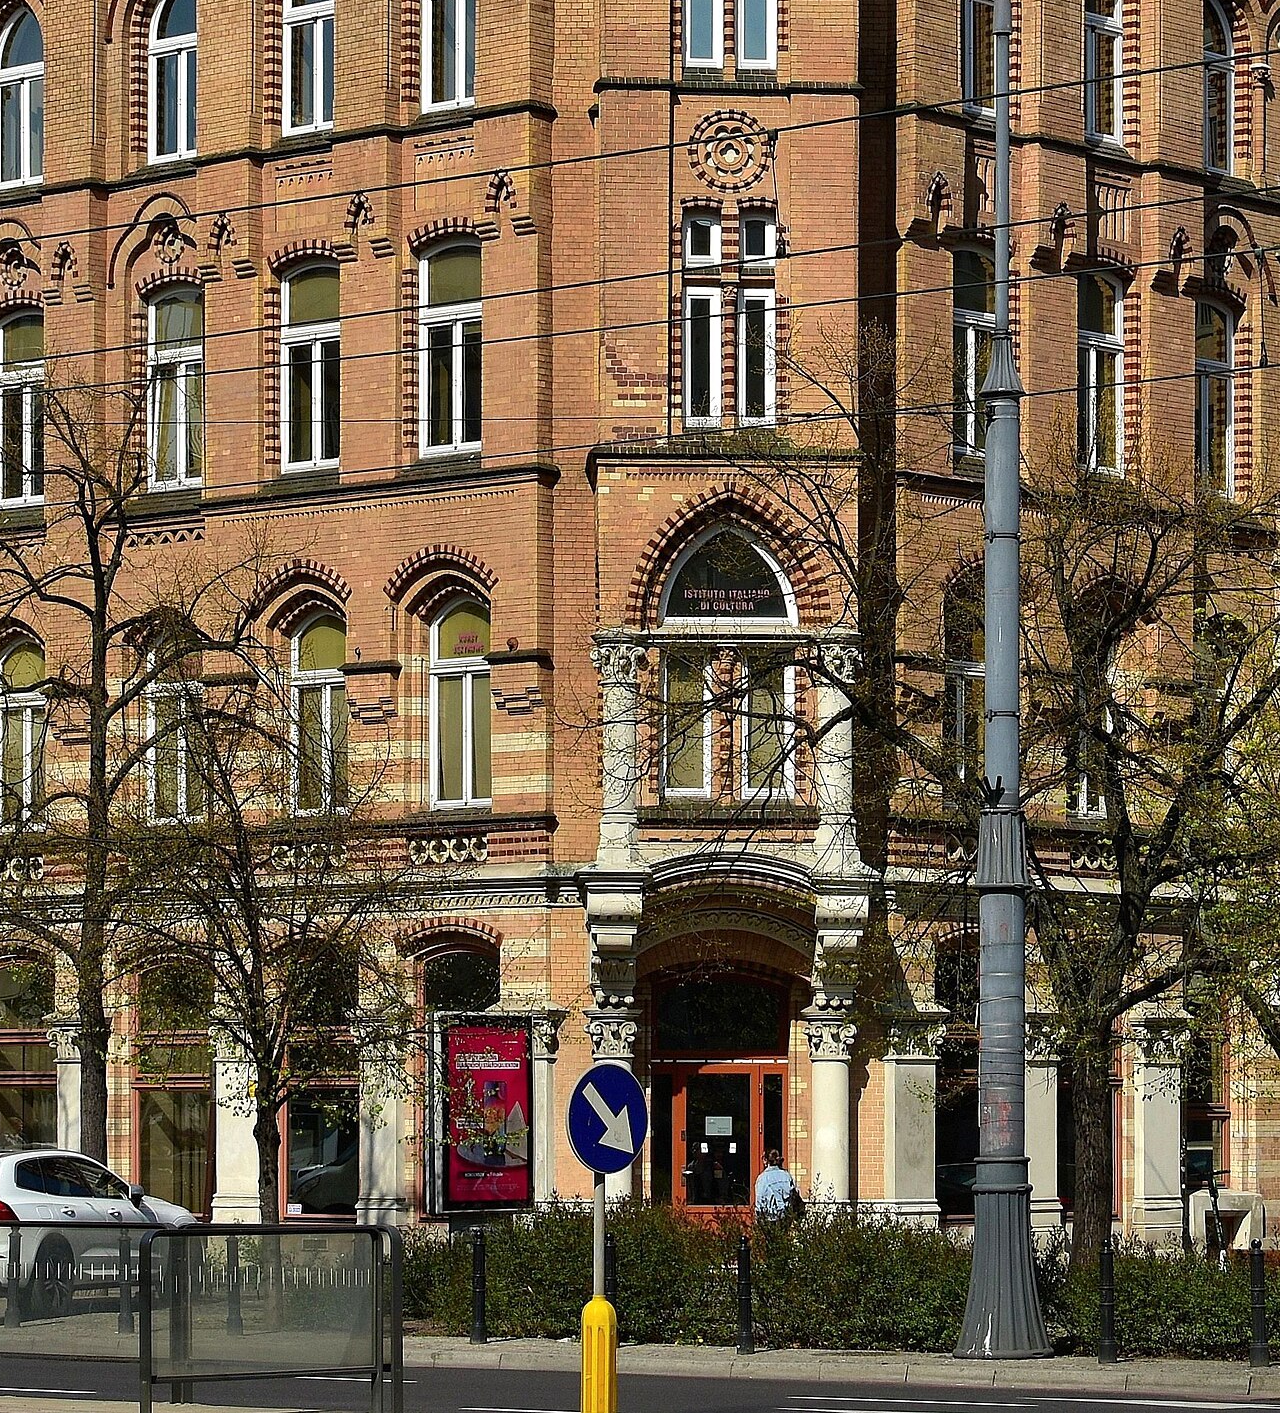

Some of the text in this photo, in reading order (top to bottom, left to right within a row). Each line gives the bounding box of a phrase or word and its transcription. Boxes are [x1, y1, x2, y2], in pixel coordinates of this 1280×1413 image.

[684, 589, 770, 599] ISTITUTO ITALIANO
[700, 601, 754, 611] DI CULTURA
